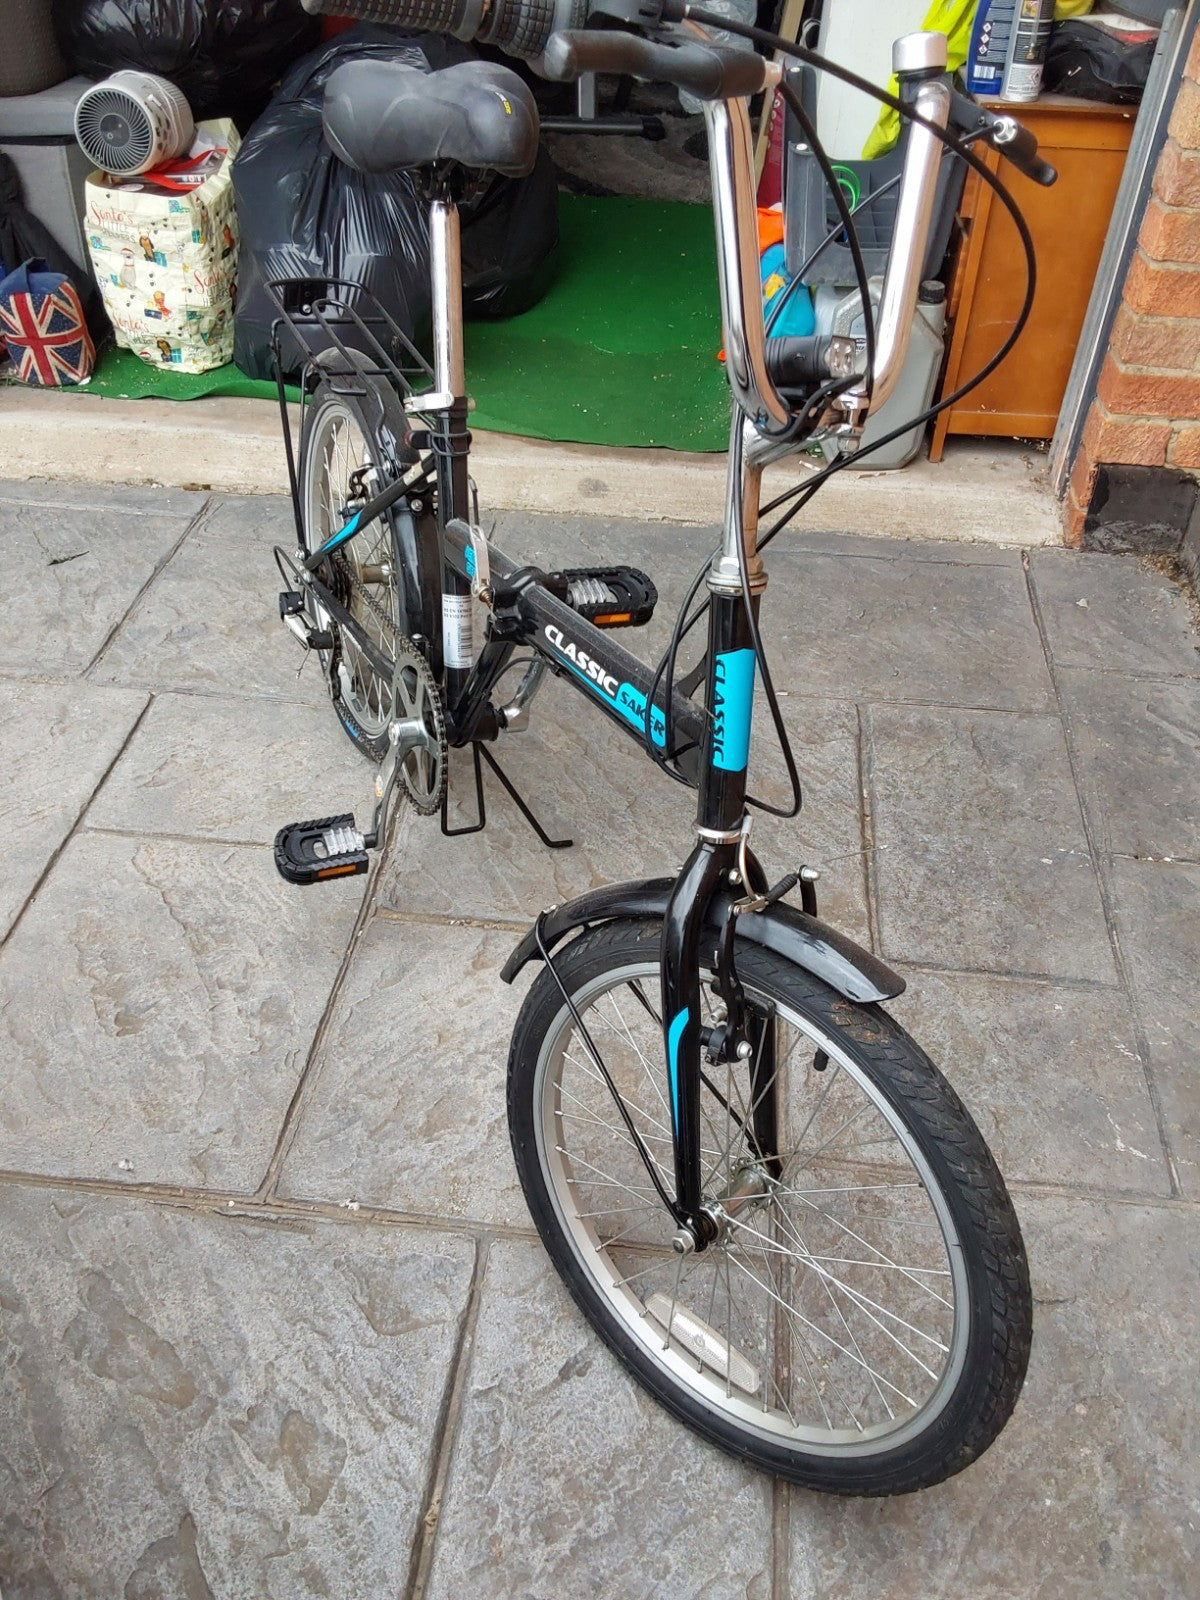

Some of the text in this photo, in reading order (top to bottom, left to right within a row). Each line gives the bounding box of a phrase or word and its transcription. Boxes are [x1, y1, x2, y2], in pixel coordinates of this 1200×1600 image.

[90, 200, 134, 226] Santa's
[545, 624, 619, 697] CLASSIC
[711, 659, 726, 763] CLASSIC
